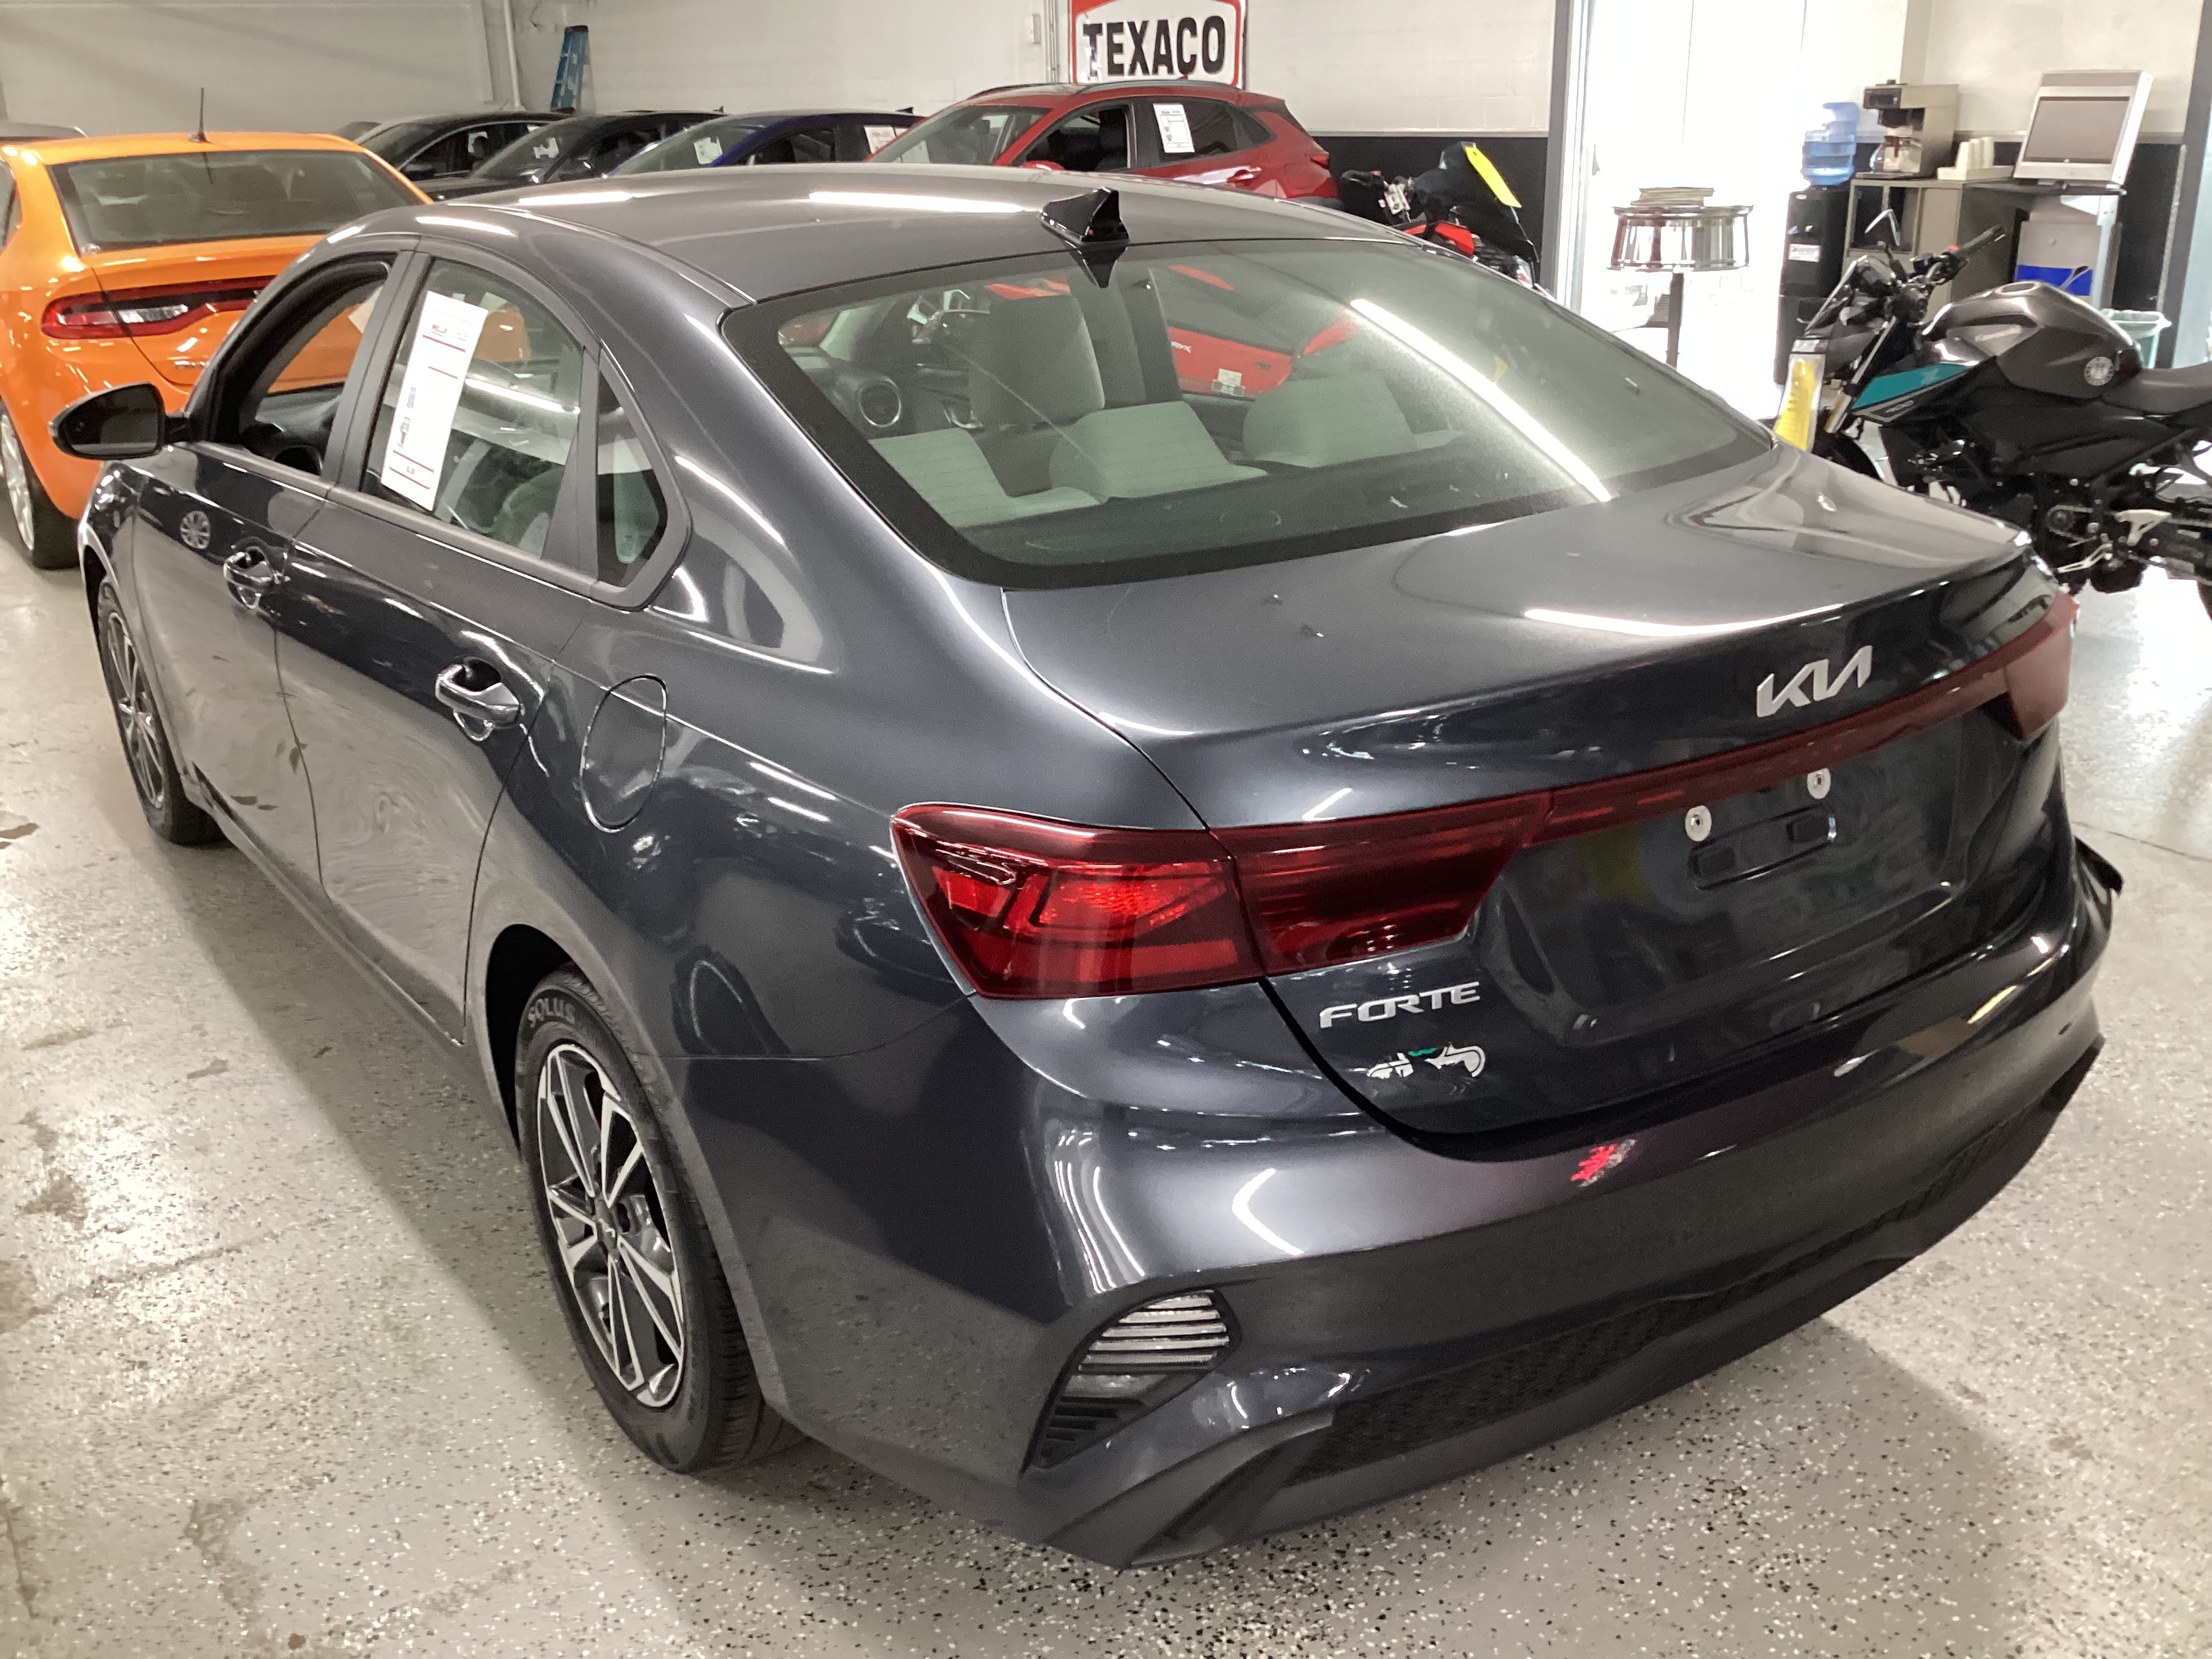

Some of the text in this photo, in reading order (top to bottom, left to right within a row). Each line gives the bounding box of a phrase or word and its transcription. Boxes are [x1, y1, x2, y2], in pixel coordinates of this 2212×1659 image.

[1083, 15, 1226, 76] TEXACO
[1757, 645, 1872, 718] KIA
[528, 998, 576, 1028] SOLUS
[1319, 981, 1481, 1029] FORTE
